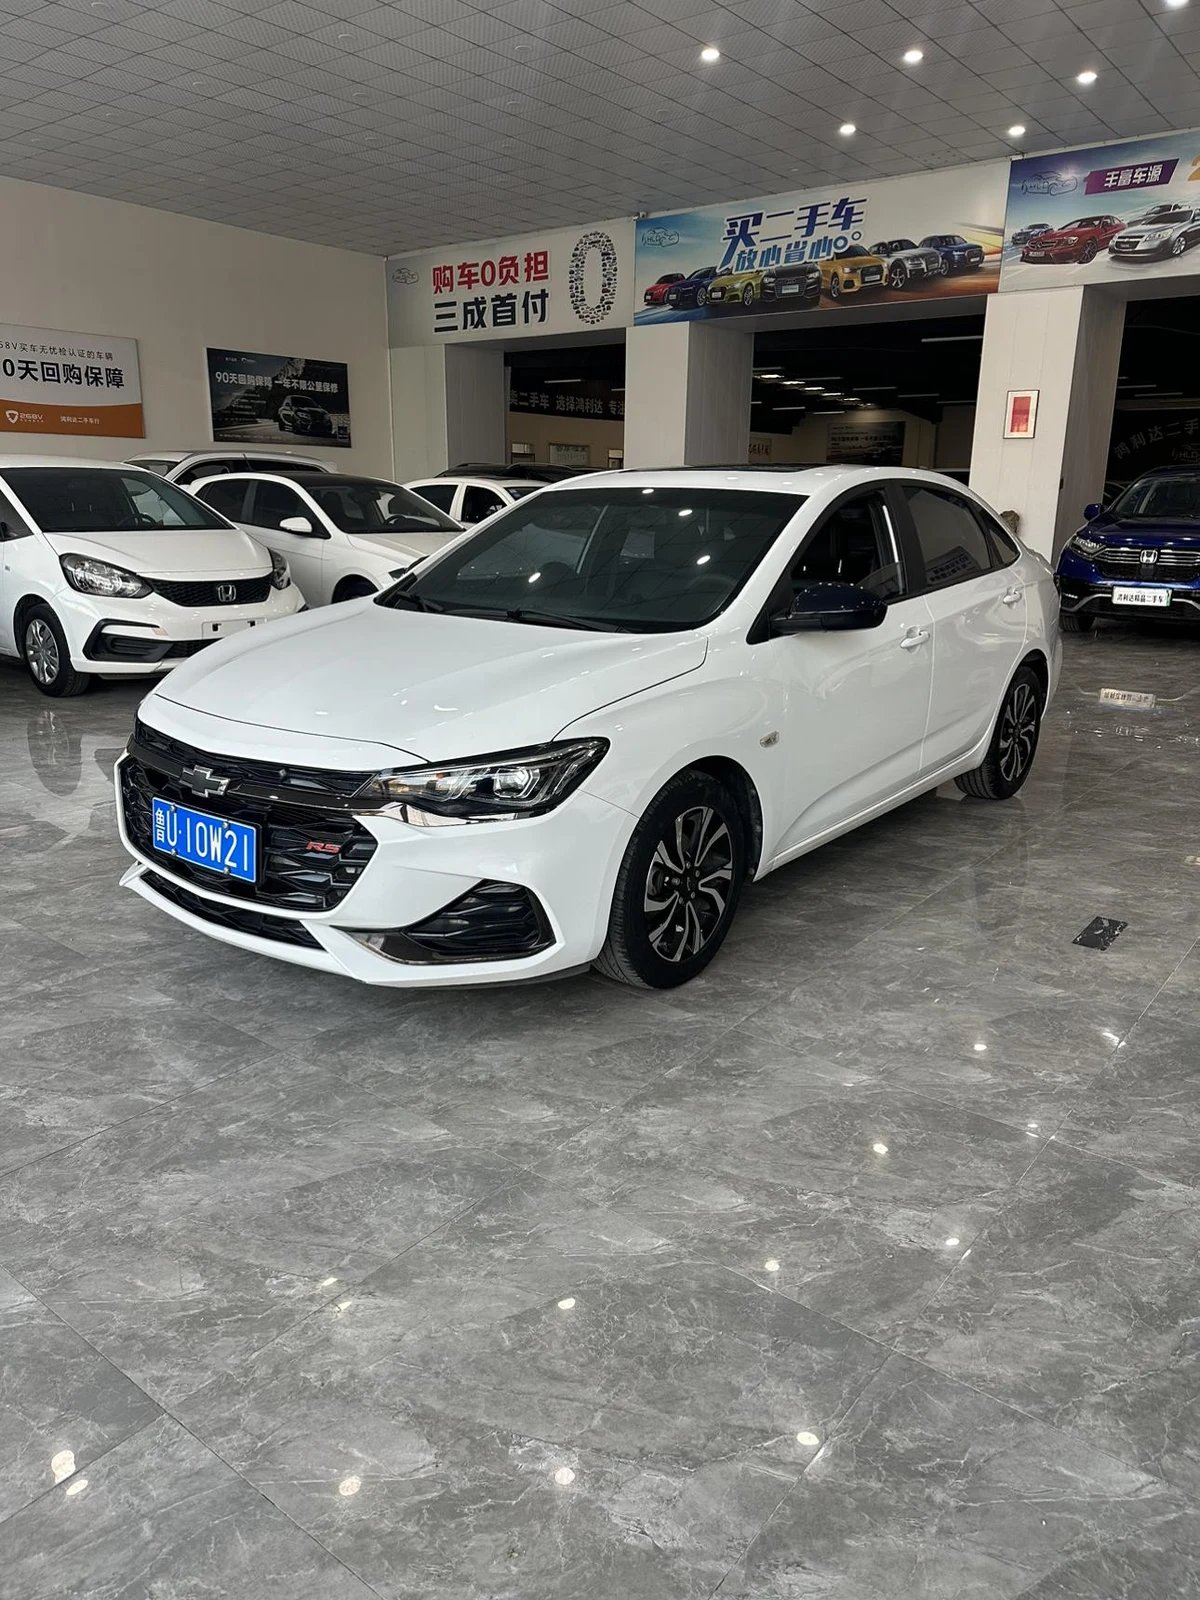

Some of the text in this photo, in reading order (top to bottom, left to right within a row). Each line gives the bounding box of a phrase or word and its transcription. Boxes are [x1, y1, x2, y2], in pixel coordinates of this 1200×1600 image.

[1104, 164, 1161, 188] 丰富车源
[720, 197, 867, 266] 买二手车
[432, 251, 550, 295] 购车0负担
[434, 288, 550, 333] 三成首付
[2, 358, 125, 389] 0天回购保障
[305, 841, 341, 855] RS
